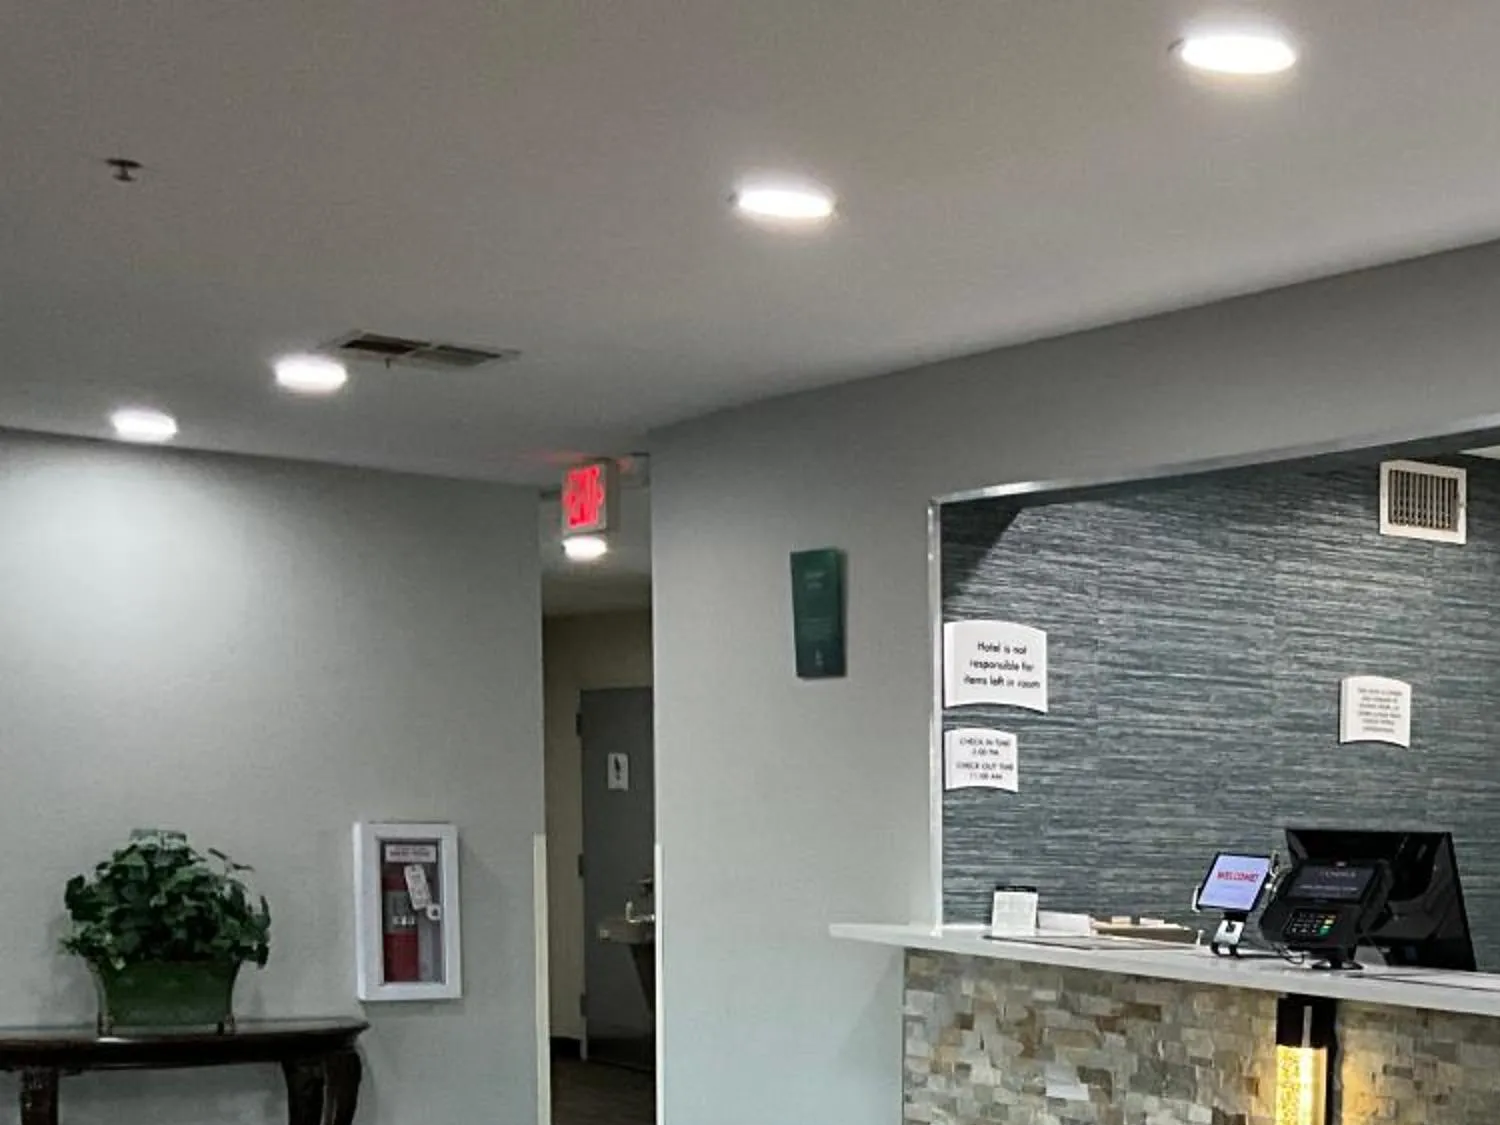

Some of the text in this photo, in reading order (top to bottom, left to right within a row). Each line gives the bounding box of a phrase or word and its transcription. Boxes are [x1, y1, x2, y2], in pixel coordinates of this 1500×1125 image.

[977, 641, 1027, 655] Hotel is not
[970, 659, 1020, 671] responsible
[989, 676, 1004, 687] left
[1006, 679, 1015, 687] in
[1017, 681, 1041, 689] room
